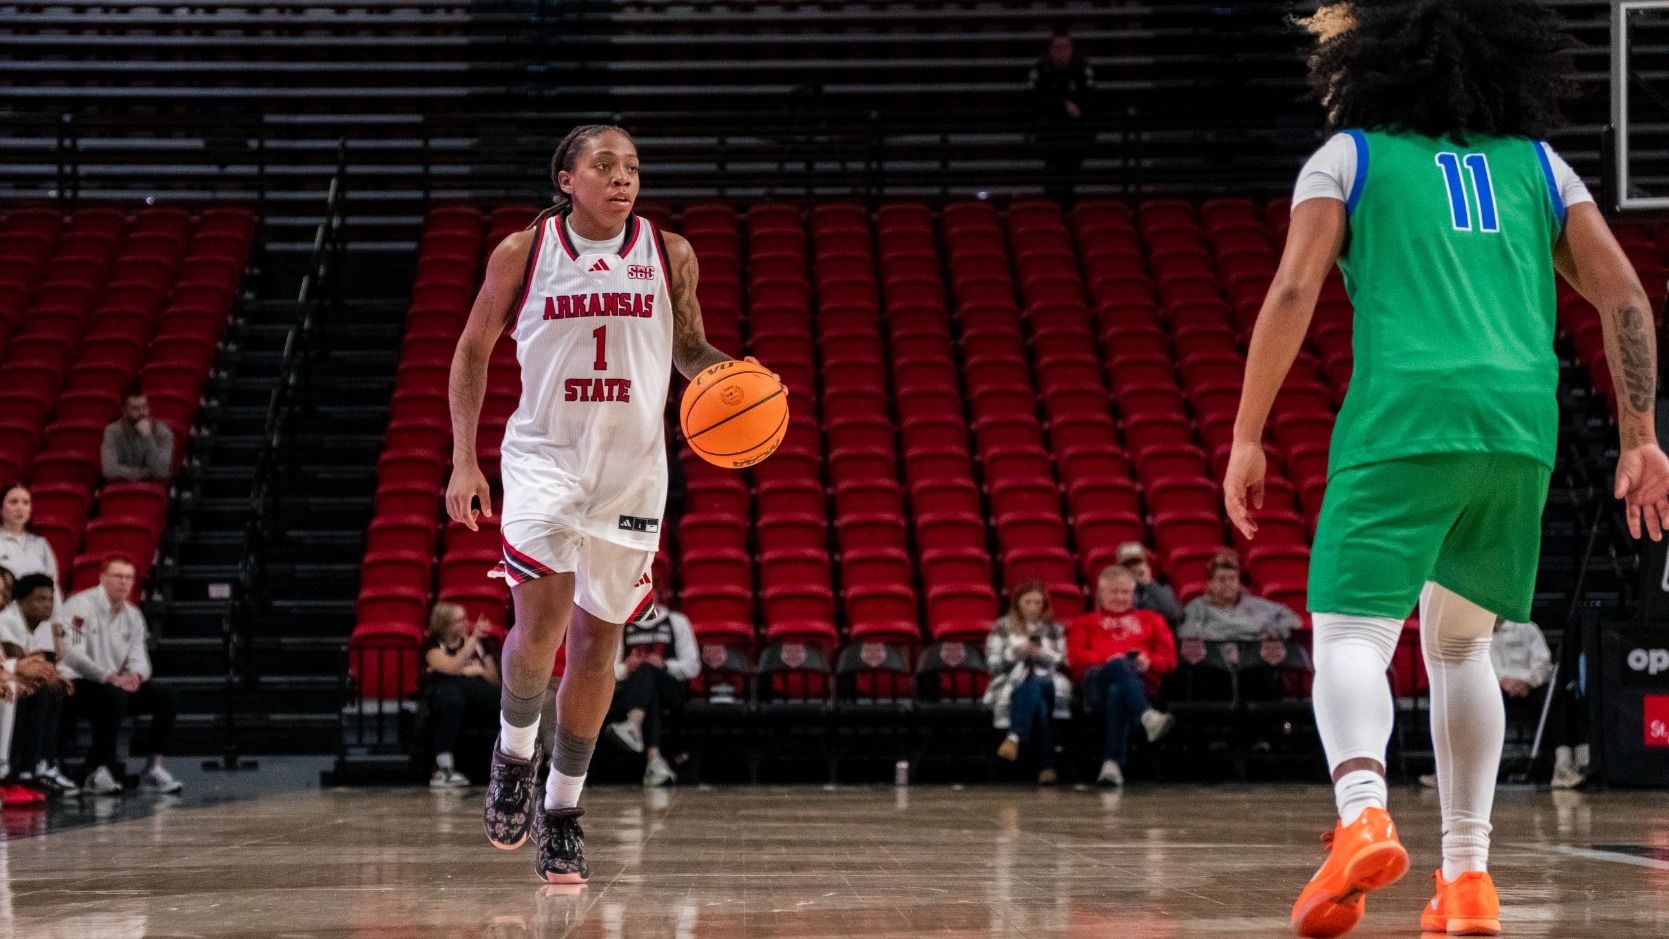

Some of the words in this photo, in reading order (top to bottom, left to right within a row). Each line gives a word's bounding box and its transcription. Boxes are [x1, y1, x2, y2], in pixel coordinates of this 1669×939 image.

[1435, 152, 1500, 233] 11
[627, 265, 655, 280] SBC
[543, 292, 655, 320] ARKANSAS
[592, 325, 607, 371] 1
[564, 378, 632, 403] STATE
